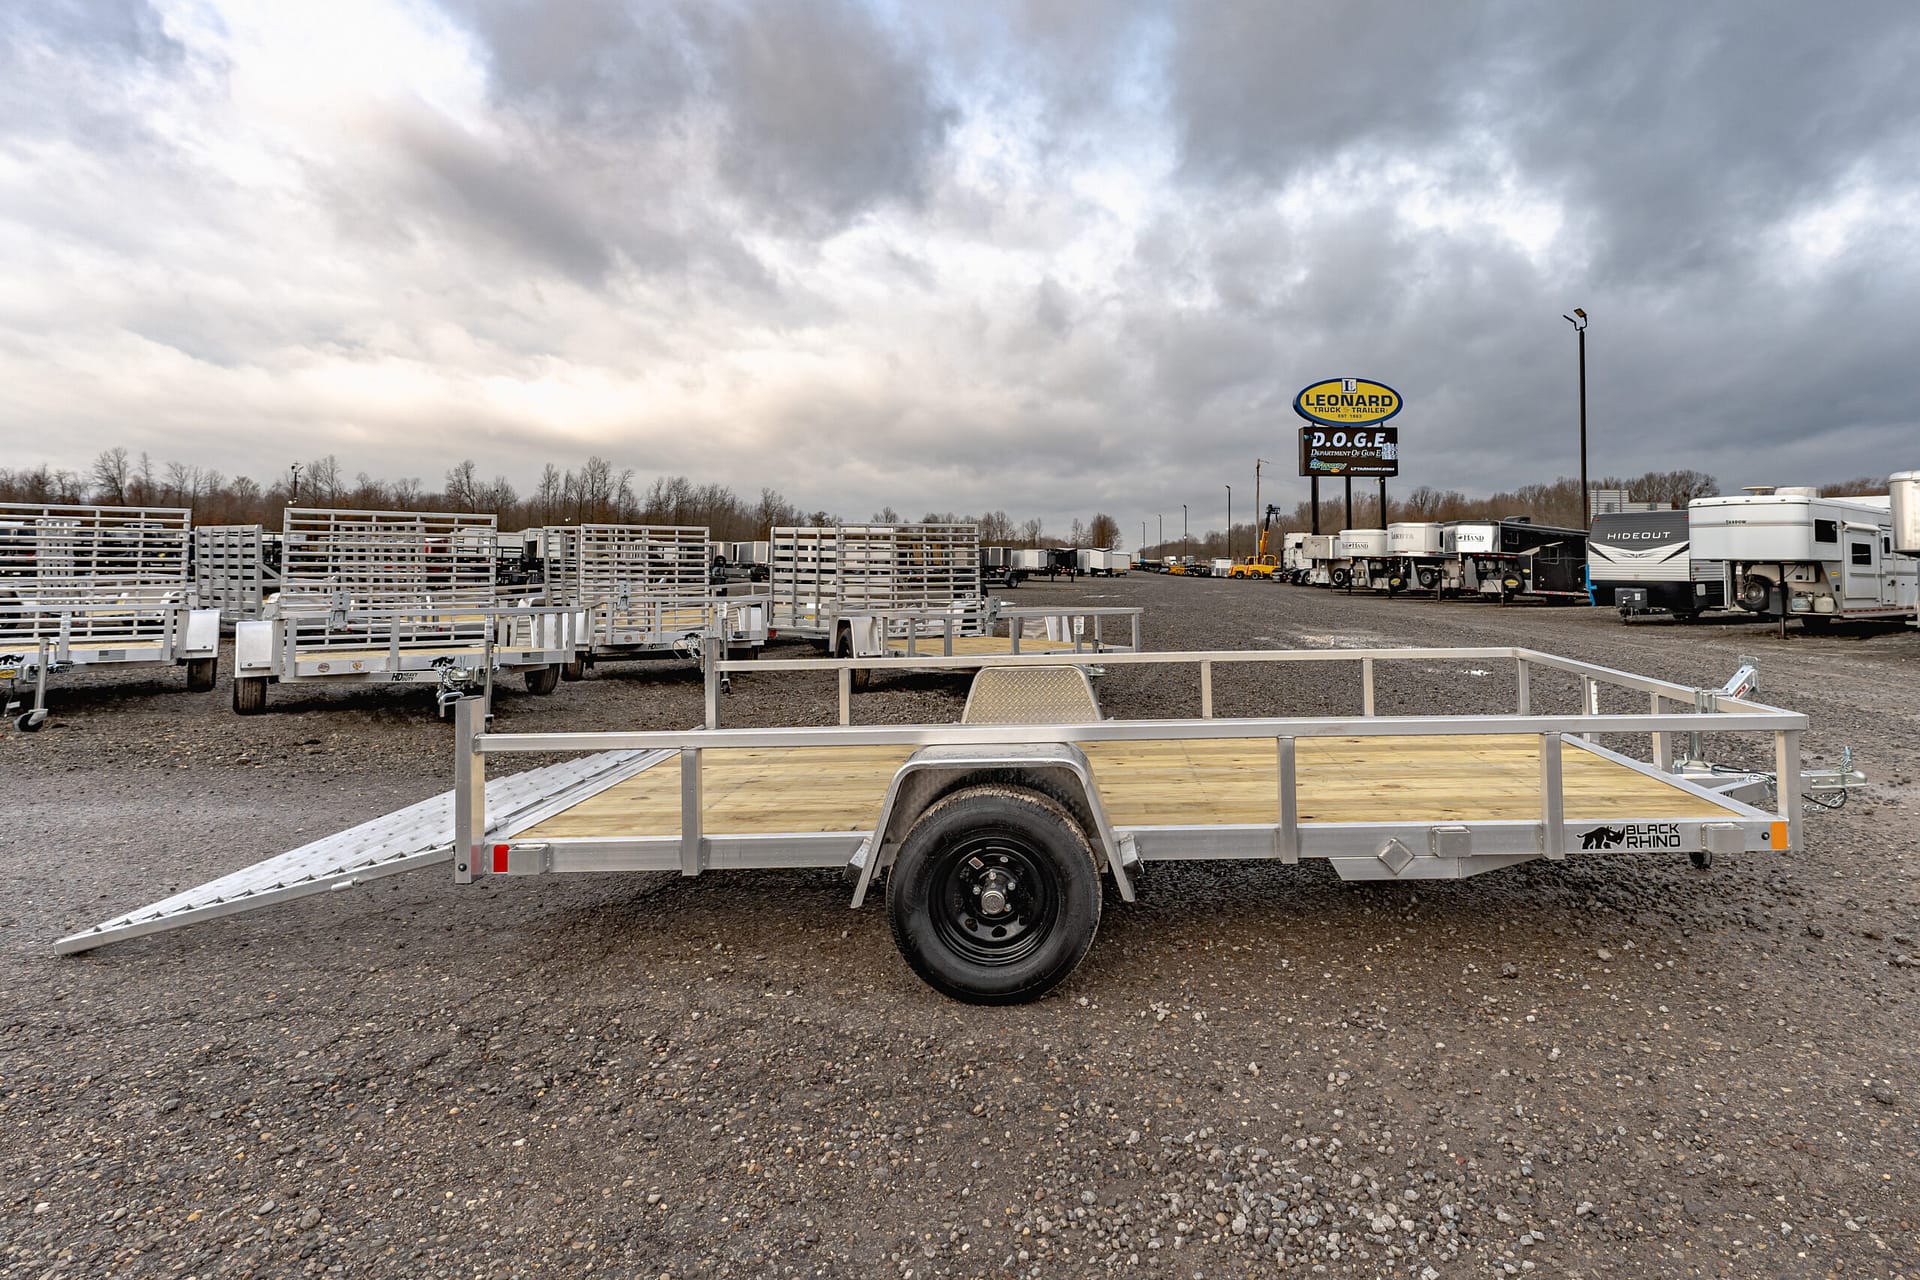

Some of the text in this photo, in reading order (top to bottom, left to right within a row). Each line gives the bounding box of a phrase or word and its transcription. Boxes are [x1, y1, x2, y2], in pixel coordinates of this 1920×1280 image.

[1305, 394, 1393, 407] LEONARD
[1607, 531, 1671, 540] HIDEOUT
[391, 672, 403, 682] HD
[1625, 823, 1680, 835] BLACK
[1626, 834, 1681, 849] RHINO
